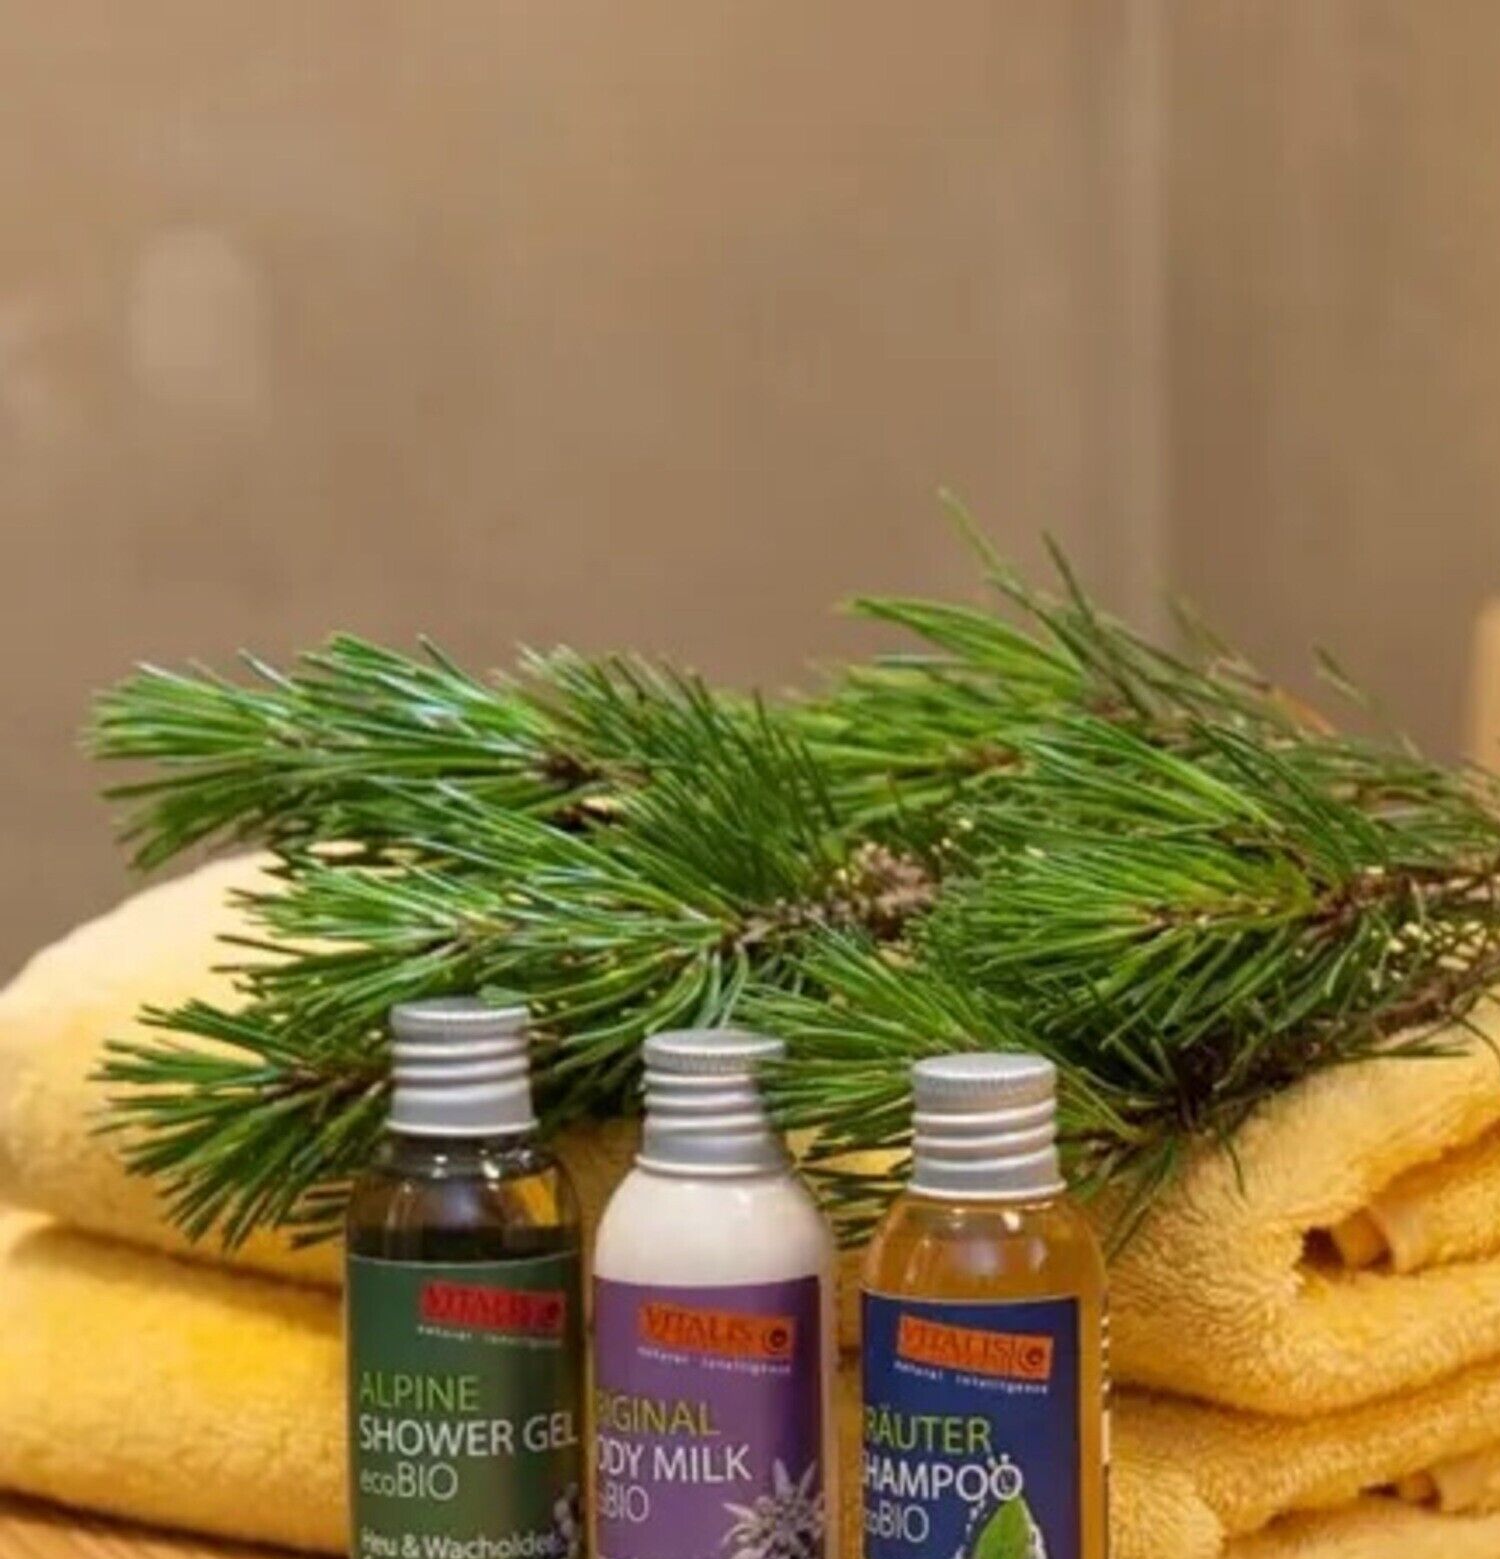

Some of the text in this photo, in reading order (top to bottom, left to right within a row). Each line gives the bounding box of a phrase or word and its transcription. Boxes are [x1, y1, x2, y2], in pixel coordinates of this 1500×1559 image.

[645, 1303, 754, 1343] VITALIS
[902, 1319, 1009, 1359] VITALIS
[360, 1371, 480, 1412] ALPINE
[359, 1411, 578, 1458] SHOWER GEL
[864, 1402, 993, 1454] RÄUTER
[597, 1434, 753, 1484] ODY MILK
[862, 1450, 1024, 1502] HAMPOO
[359, 1460, 459, 1500] ecoBIO
[401, 1533, 421, 1559] &
